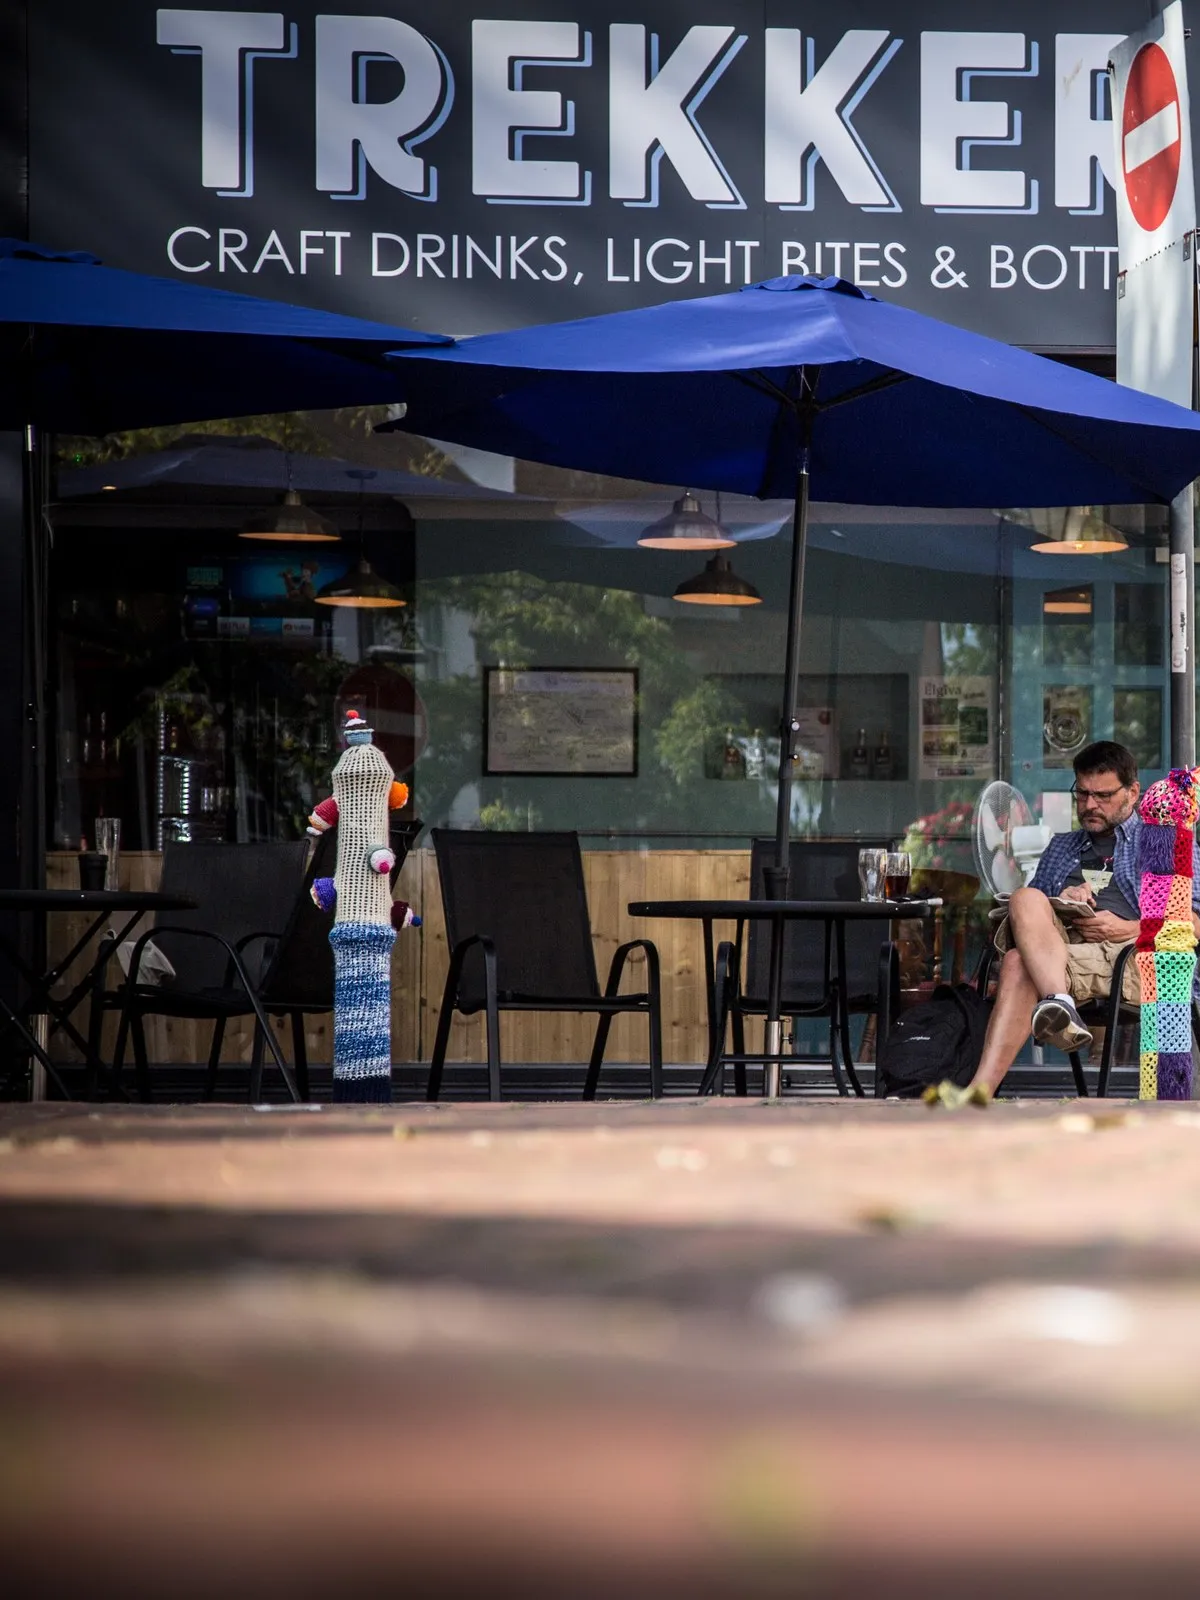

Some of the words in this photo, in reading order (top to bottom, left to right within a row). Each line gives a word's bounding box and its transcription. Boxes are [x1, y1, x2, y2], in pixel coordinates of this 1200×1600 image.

[166, 225, 351, 277] CRAFT
[371, 231, 585, 287] DRINKS,
[606, 236, 760, 285] LIGHT
[781, 240, 908, 288] BITES
[929, 244, 970, 289] &
[990, 243, 1120, 290] BOTT
